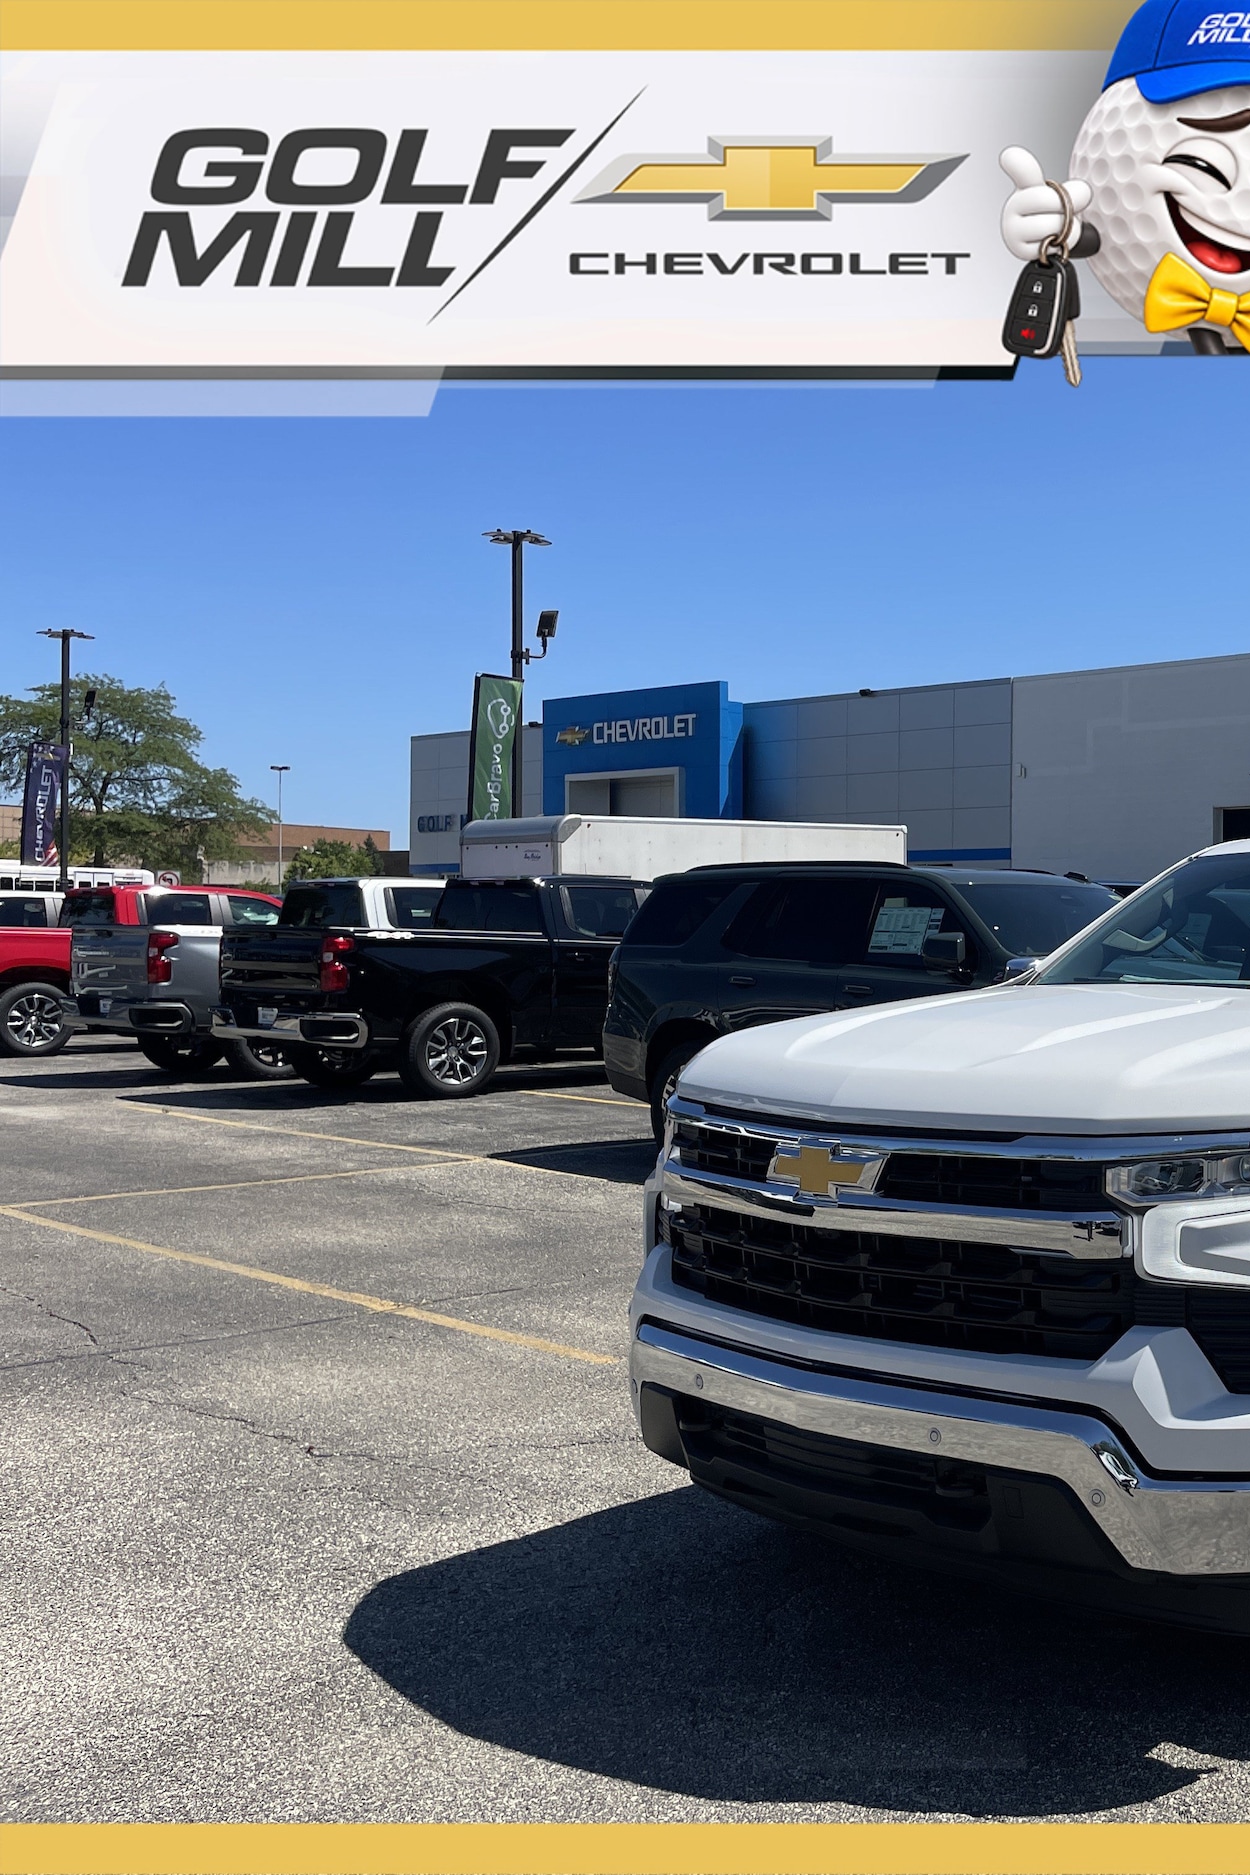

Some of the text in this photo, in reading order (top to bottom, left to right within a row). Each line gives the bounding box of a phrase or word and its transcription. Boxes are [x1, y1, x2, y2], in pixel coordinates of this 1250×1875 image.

[593, 713, 697, 744] CHEVROLET
[34, 765, 53, 862] CHEVROLET
[417, 815, 453, 833] GOLF
